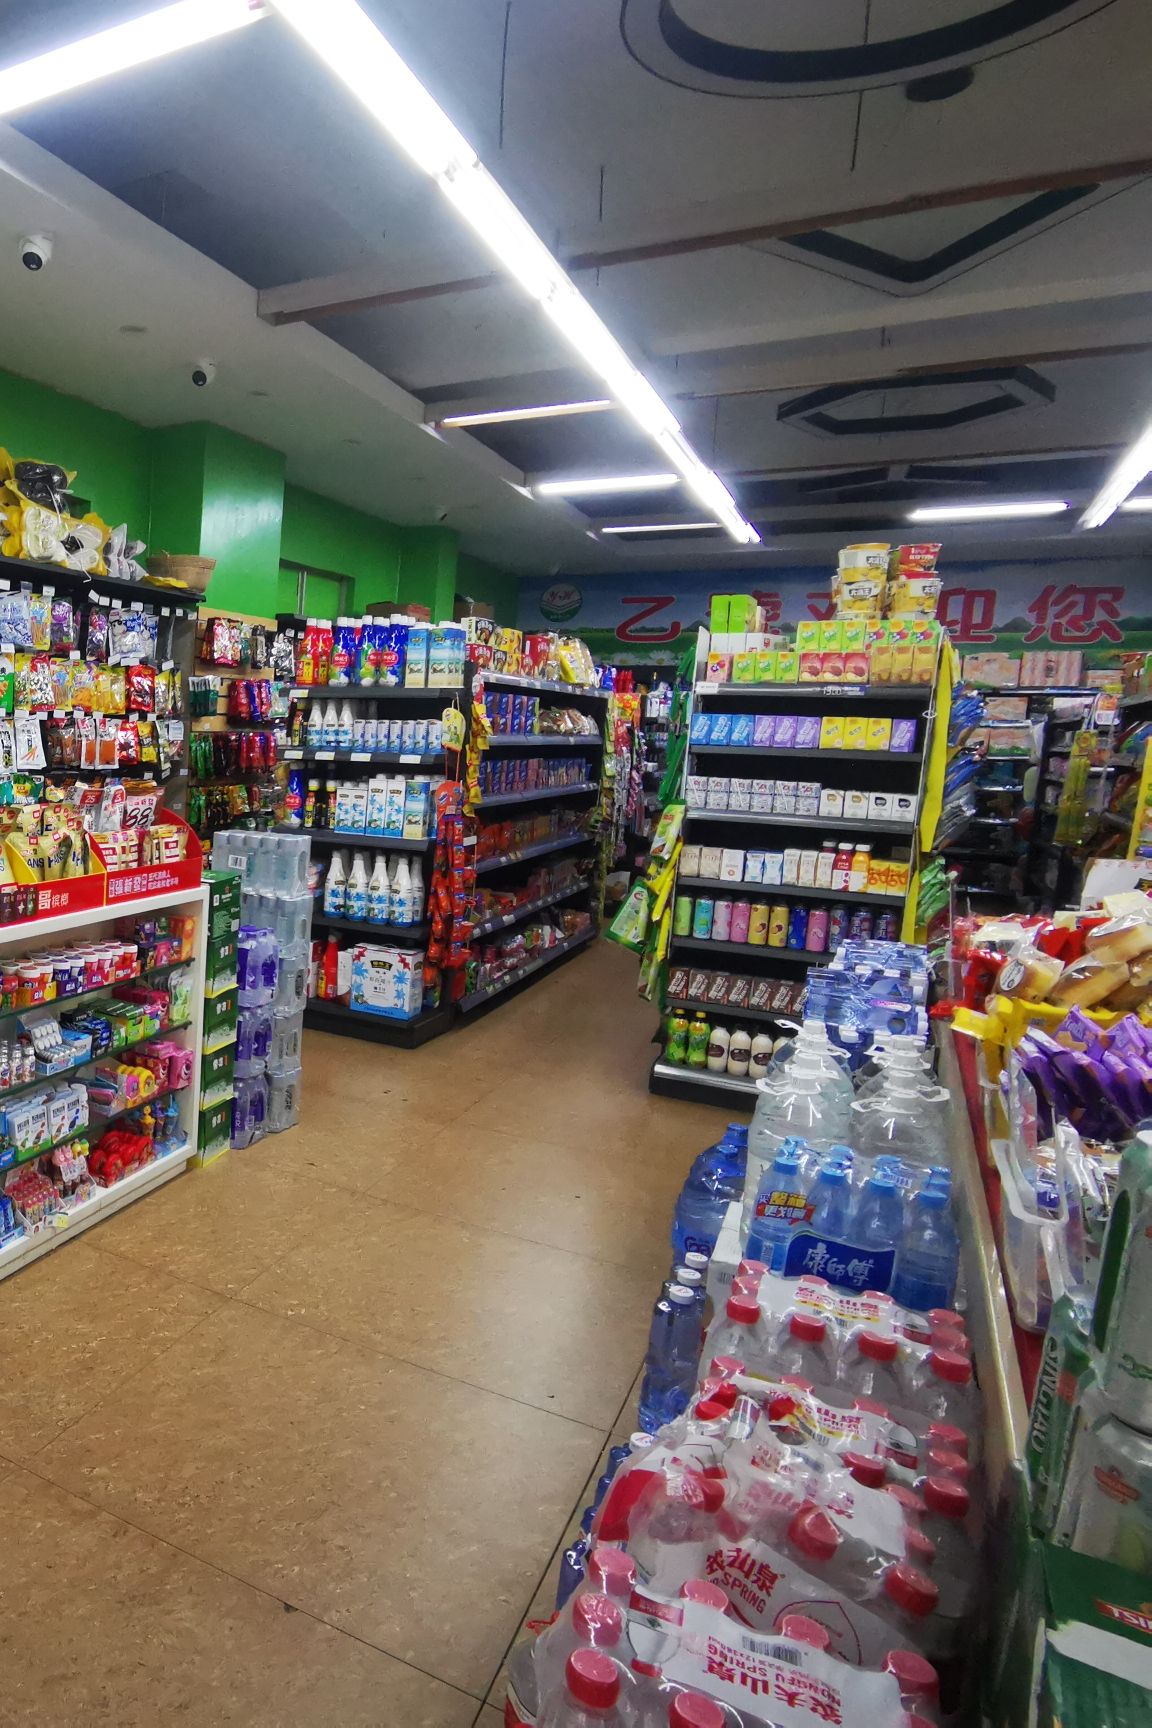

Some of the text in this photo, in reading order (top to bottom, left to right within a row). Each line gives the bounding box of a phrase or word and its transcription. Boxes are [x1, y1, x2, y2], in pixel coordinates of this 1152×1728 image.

[127, 807, 153, 829] 88
[721, 1571, 767, 1615] SPRING
[707, 1643, 768, 1678] SPRING
[706, 1655, 843, 1726] 农夫山泉
